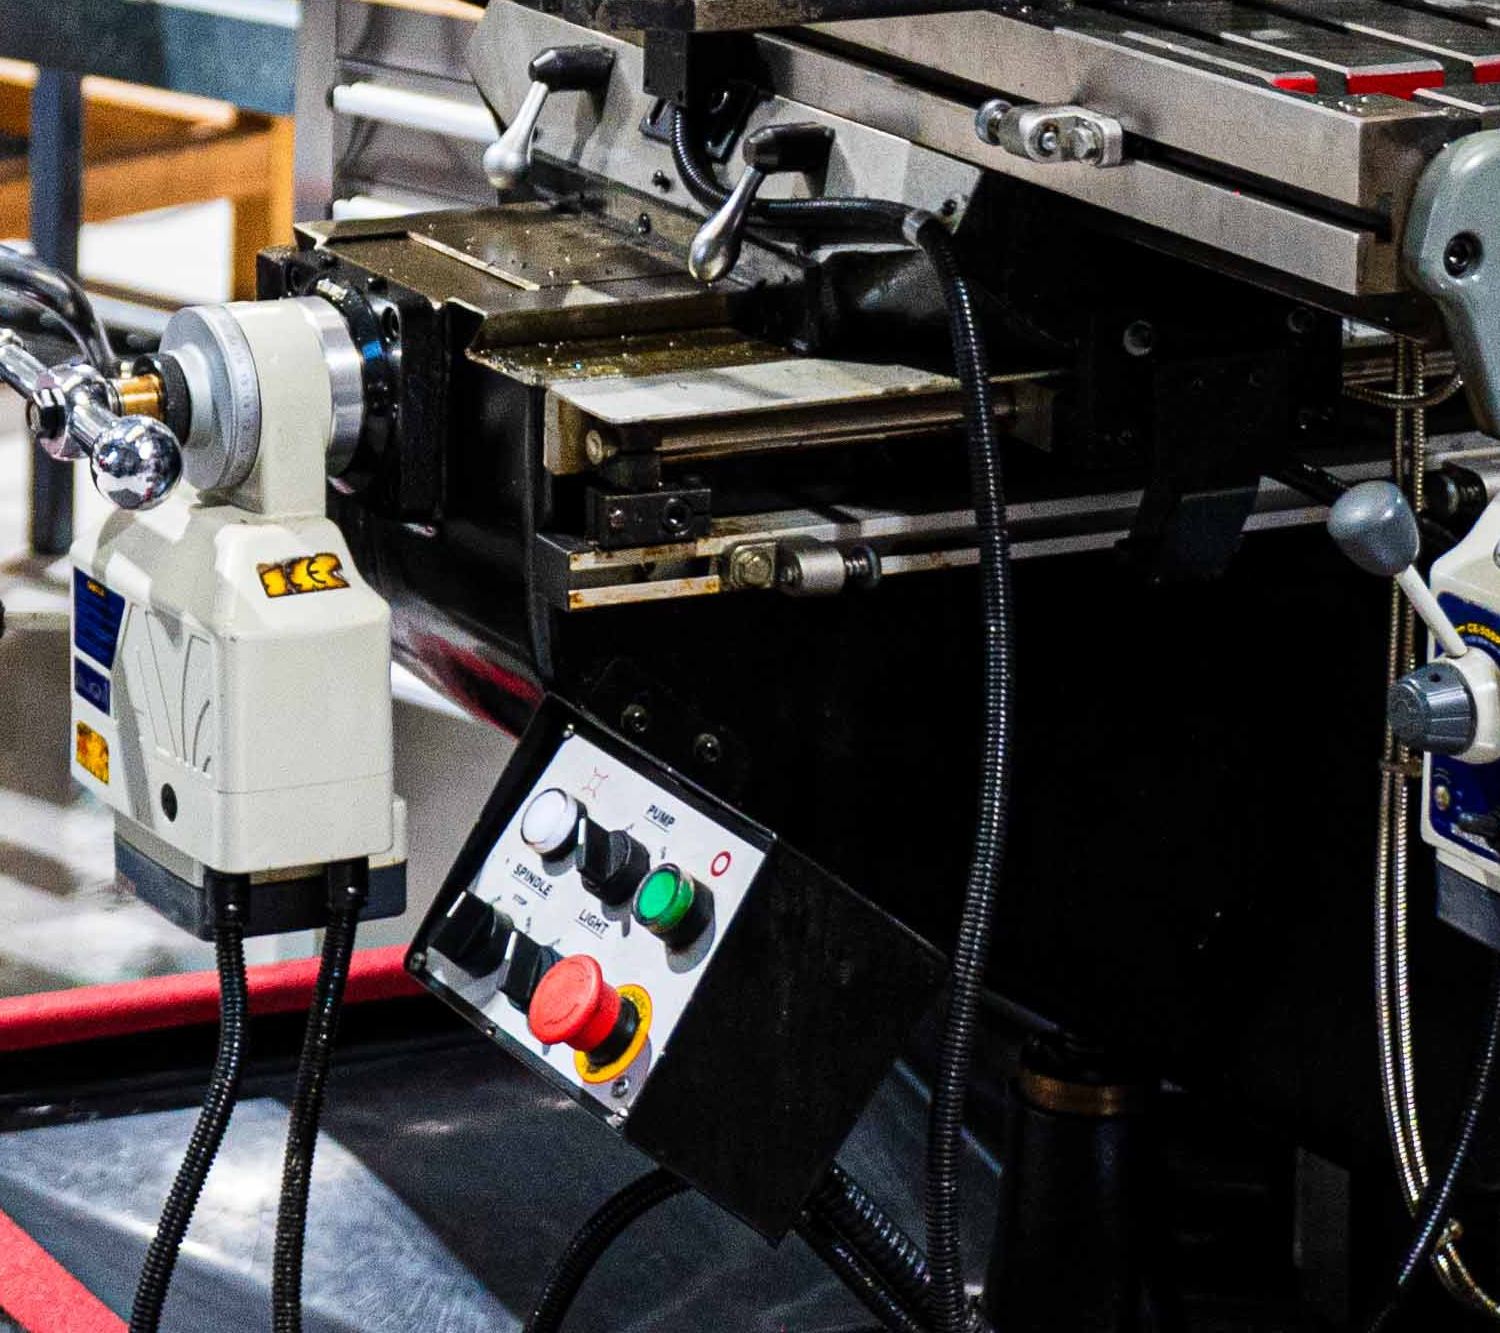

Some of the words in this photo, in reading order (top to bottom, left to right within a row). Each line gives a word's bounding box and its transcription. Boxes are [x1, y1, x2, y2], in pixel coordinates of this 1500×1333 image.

[647, 804, 676, 827] PUMP
[513, 863, 553, 896] SPINDLE
[578, 909, 609, 933] LIGHT
